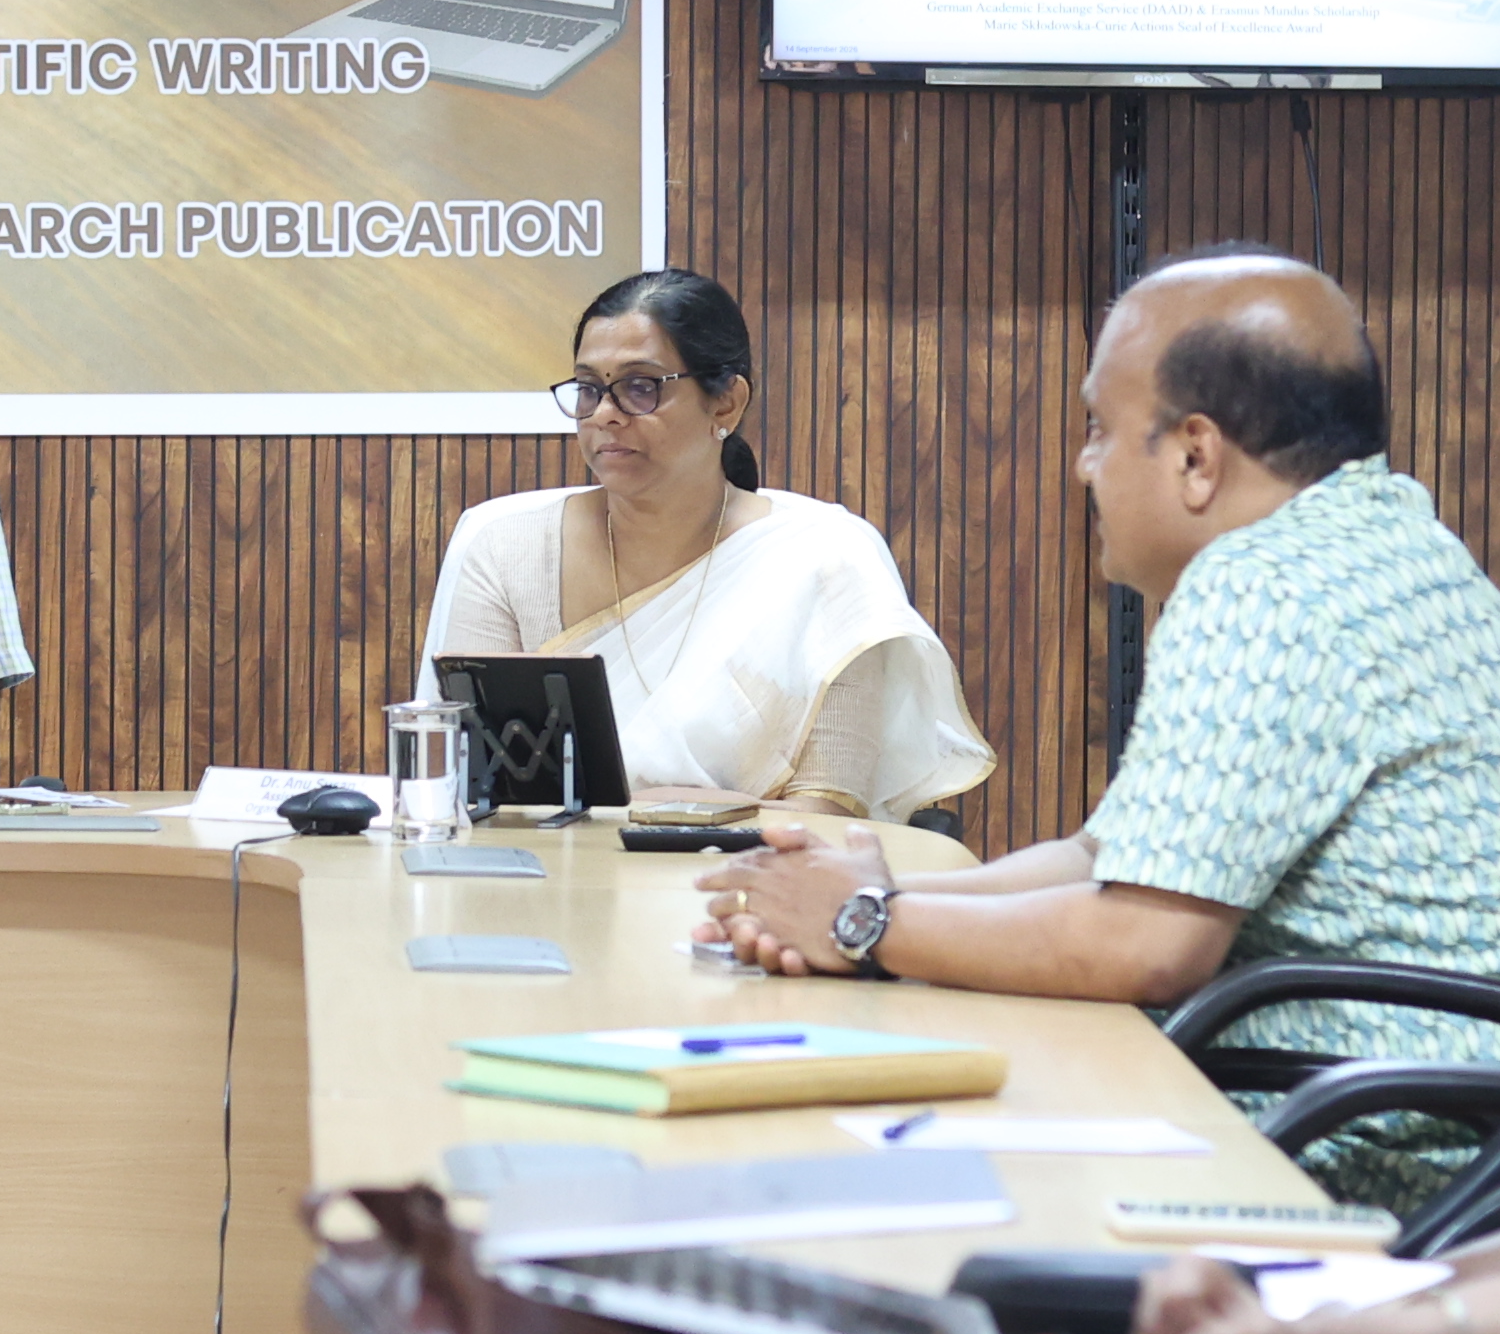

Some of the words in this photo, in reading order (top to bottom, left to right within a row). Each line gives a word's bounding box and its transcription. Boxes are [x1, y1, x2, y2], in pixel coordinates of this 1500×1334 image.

[926, 1, 973, 13] German
[976, 2, 1034, 14] Academic
[1036, 3, 1093, 16] Exchange
[1096, 3, 1139, 15] Service
[1142, 3, 1193, 16] (DAAD)
[1196, 5, 1206, 16] &
[1211, 5, 1260, 16] Erasmus
[1263, 5, 1310, 17] Mundus
[1313, 5, 1380, 20] Scholarship
[984, 19, 1018, 31] Marie
[1129, 20, 1174, 32] Actions
[1177, 21, 1202, 33] Seal
[1205, 21, 1219, 33] of
[1220, 22, 1283, 34] Excellence
[1286, 22, 1323, 34] Award
[796, 45, 837, 53] September
[152, 42, 426, 91] WRITING
[1134, 74, 1172, 84] SONY
[181, 205, 599, 253] PUBLICATION
[260, 775, 280, 788] Dr.
[283, 776, 312, 789] Anu
